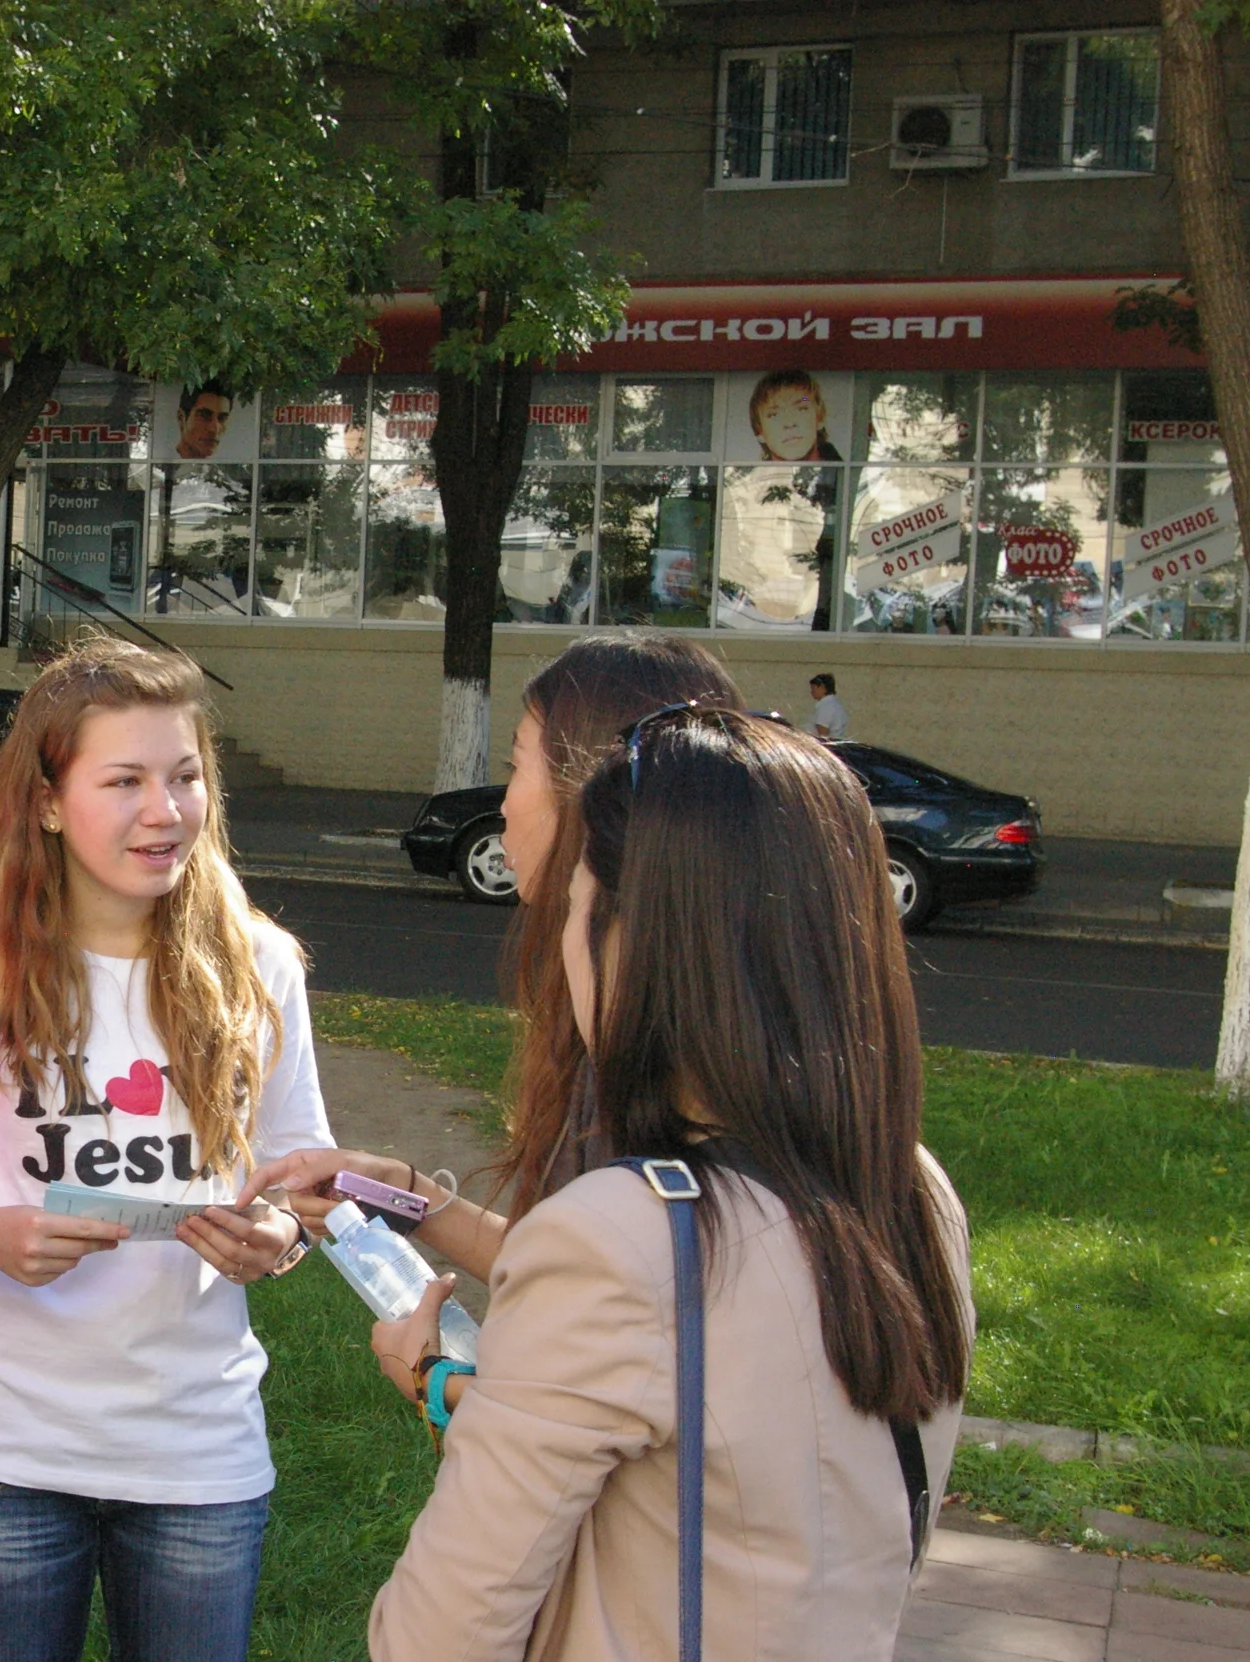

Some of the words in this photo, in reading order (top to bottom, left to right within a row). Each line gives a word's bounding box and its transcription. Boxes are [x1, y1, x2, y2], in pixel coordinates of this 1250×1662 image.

[590, 311, 830, 342] ЖСКОЙ
[851, 316, 983, 339] ЗАЛ
[275, 404, 352, 424] СТРИЖКИ
[527, 404, 589, 424] ЧЕСКИ
[1131, 422, 1223, 439] КСЕРОК
[49, 493, 99, 508] Ремонт
[47, 521, 111, 537] Продажа
[871, 503, 948, 546] СРОЧНОЕ
[1140, 506, 1219, 550] СРОЧНОЕ
[46, 547, 106, 564] Покупка
[882, 545, 934, 577] ФОТО
[1007, 542, 1063, 565] ФОТО
[1151, 549, 1207, 582] ФОТО
[22, 1123, 213, 1187] Jesu
